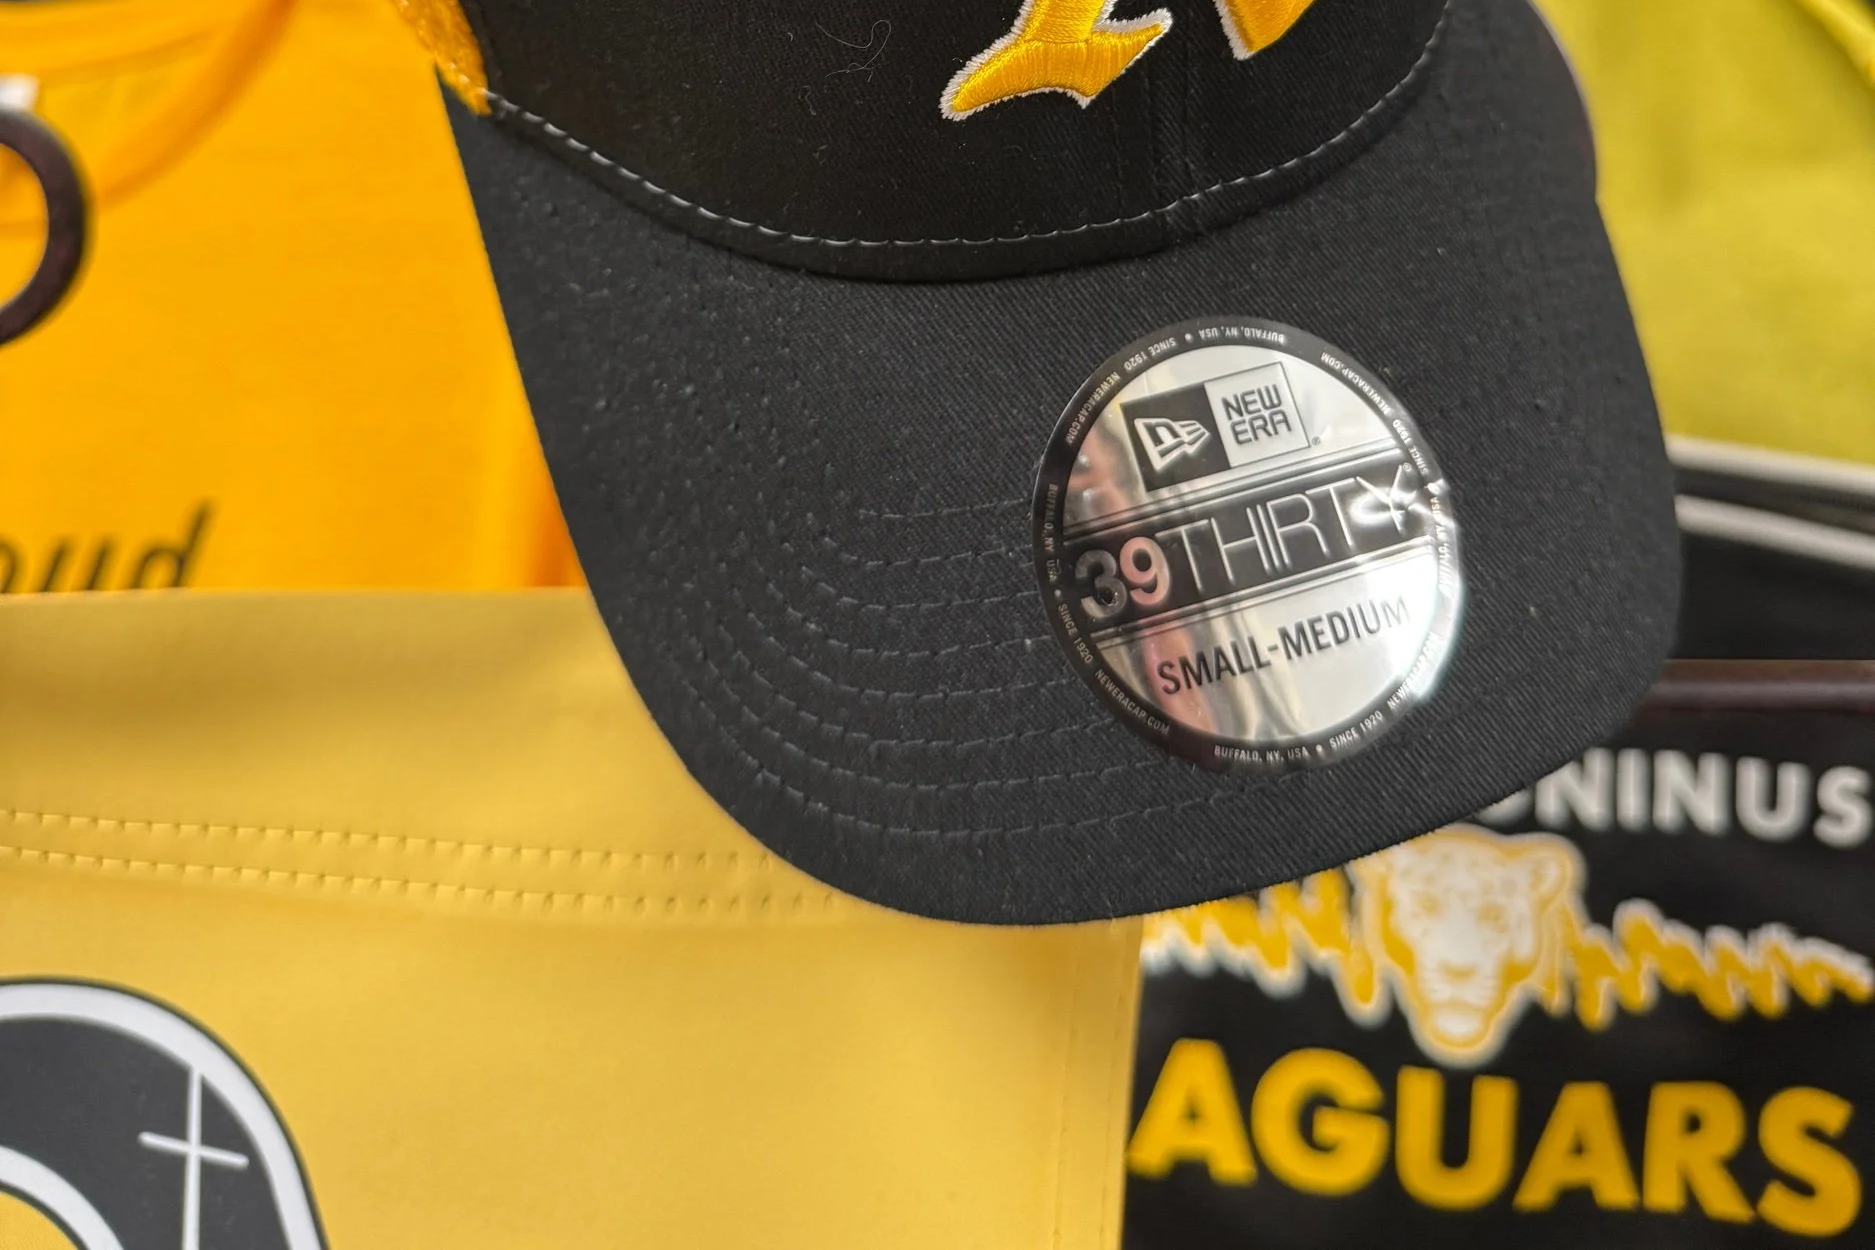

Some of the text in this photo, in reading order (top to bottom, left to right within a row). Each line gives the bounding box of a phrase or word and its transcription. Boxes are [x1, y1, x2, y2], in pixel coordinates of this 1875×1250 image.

[1198, 326, 1219, 340] USA
[1123, 337, 1177, 371] SINCE 1920
[1220, 383, 1283, 421] NEW
[1229, 409, 1293, 446] ERA
[1408, 445, 1429, 476] SINCE
[1074, 463, 1404, 618] 39THIRTY
[1059, 603, 1094, 663] SINCE 1920
[1157, 595, 1412, 695] SMALL-MEDIUM
[1329, 710, 1384, 750] SINCE 1920
[1287, 746, 1309, 758] USA
[1476, 747, 1873, 849] NINUS
